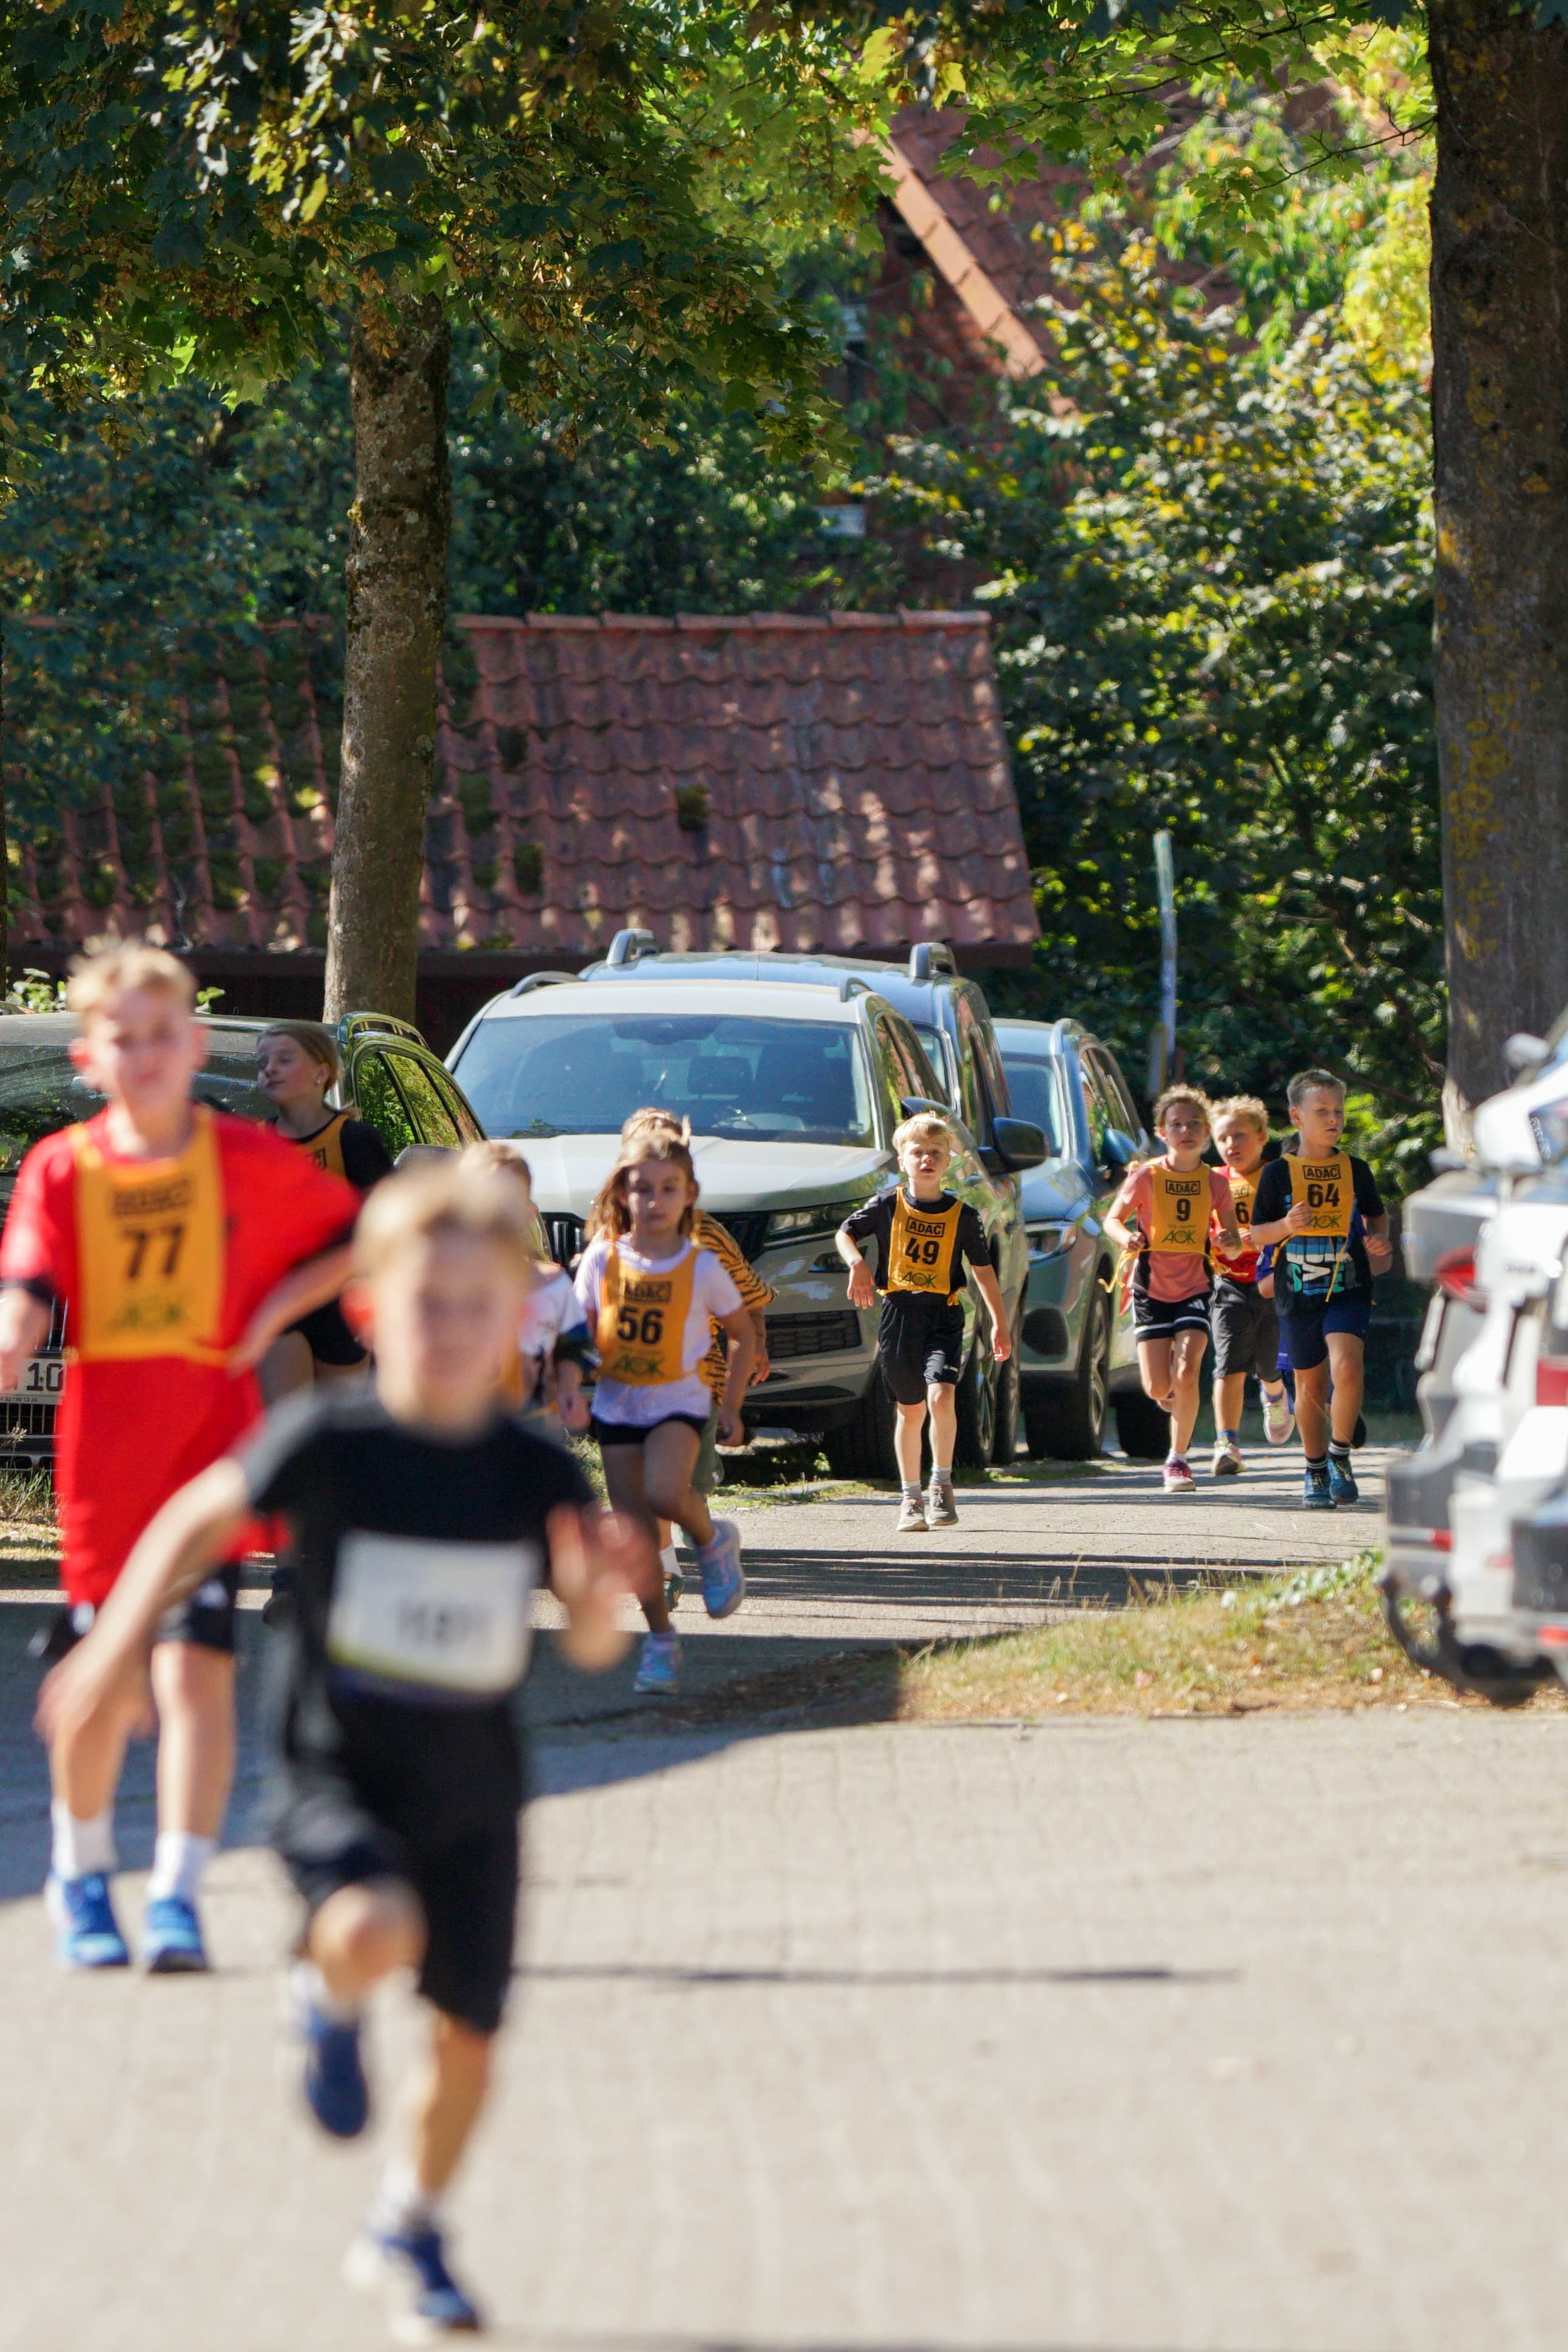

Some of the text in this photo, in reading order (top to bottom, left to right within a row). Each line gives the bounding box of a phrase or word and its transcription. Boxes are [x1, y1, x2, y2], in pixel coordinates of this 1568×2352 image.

[1306, 1168, 1339, 1179] ADAC
[1168, 1183, 1198, 1194] ADAC
[1234, 1188, 1247, 1197] AC
[1307, 1183, 1340, 1208] 64
[1177, 1198, 1191, 1222] 9
[1235, 1201, 1249, 1224] 6
[910, 1221, 942, 1235] ADAC
[1161, 1230, 1197, 1244] AOK
[121, 1225, 185, 1278] 77
[905, 1237, 939, 1265] 49
[899, 1271, 938, 1289] AOK
[618, 1307, 663, 1345] 56
[26, 1362, 64, 1391] 10
